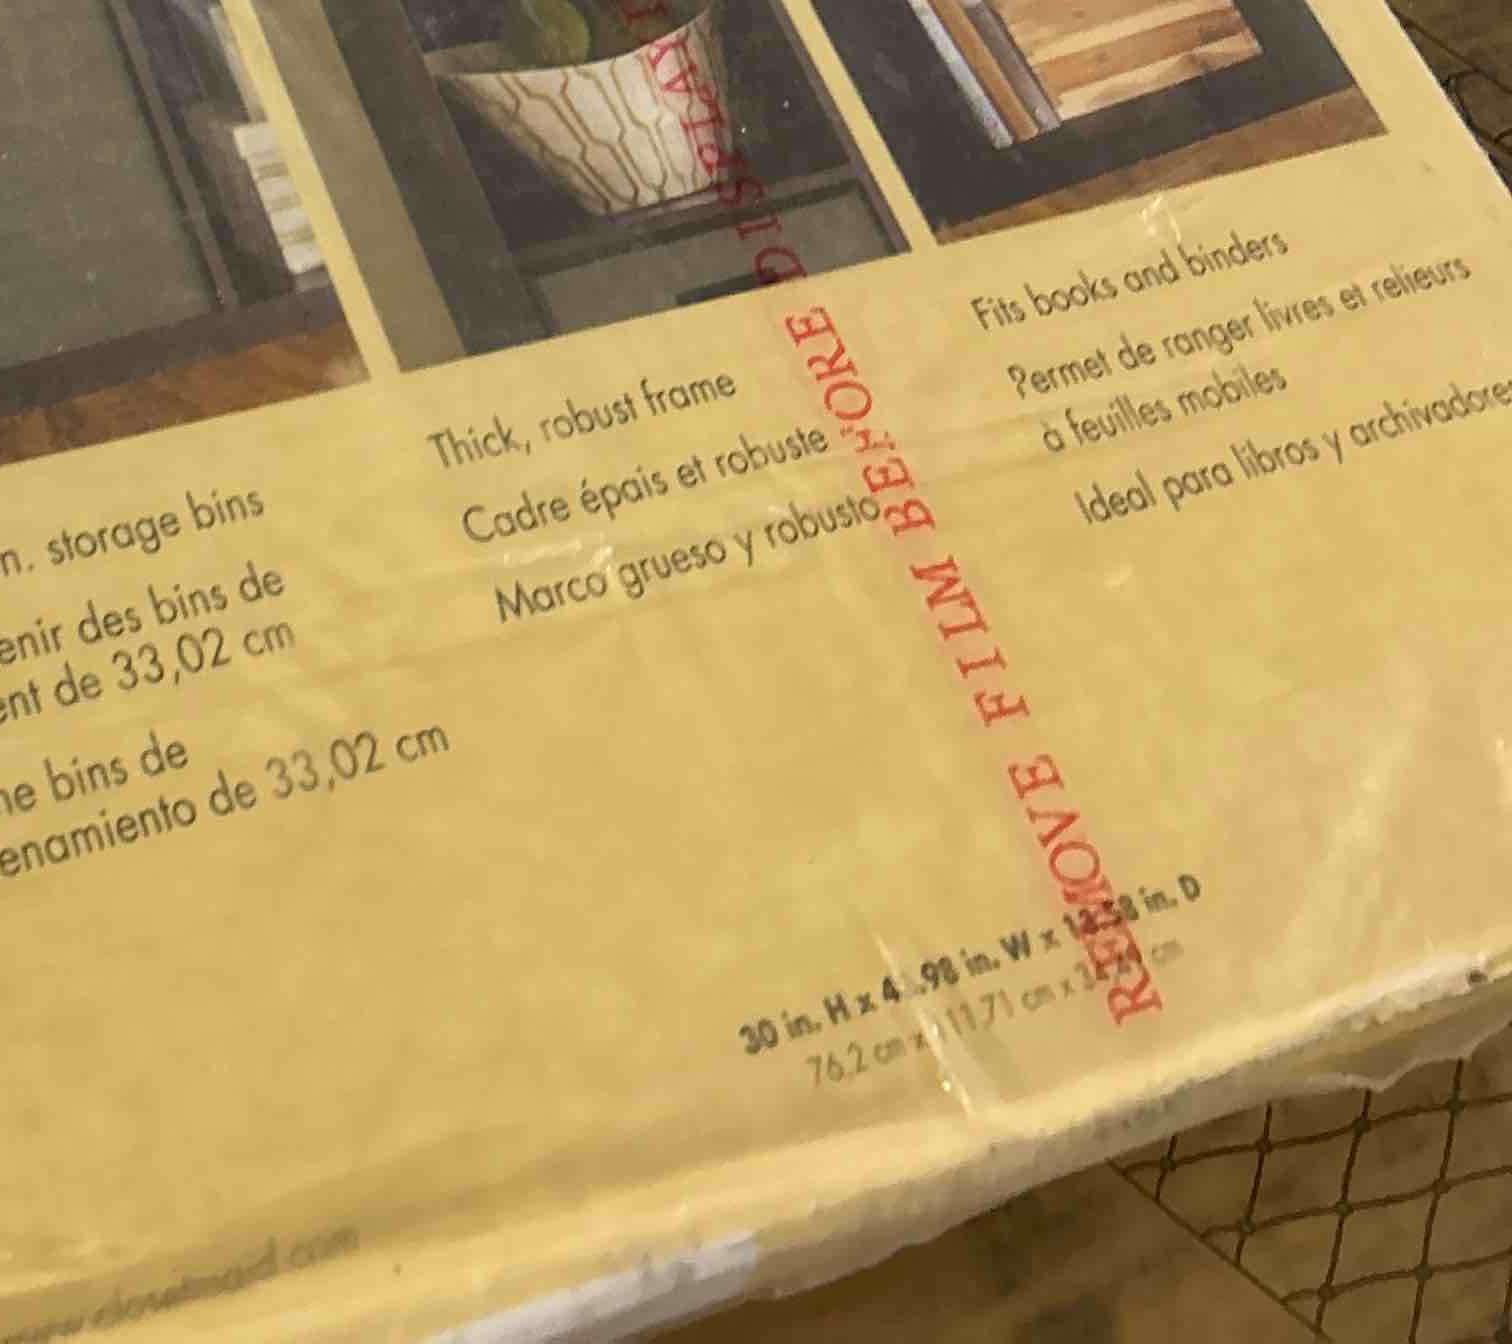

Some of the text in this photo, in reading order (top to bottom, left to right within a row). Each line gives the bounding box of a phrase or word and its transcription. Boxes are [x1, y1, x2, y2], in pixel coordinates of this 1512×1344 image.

[970, 229, 1288, 332] Fits books and binders
[1008, 254, 1471, 400] Permet de ranger livres et relieurs
[428, 372, 737, 470] Thick, robust frame
[784, 305, 935, 537] BEFORE
[1066, 391, 1172, 446] feuilles
[1177, 364, 1287, 414] mobiles
[47, 513, 182, 566] storage
[186, 490, 265, 532] bins
[461, 425, 828, 543] Cadre épais et robuste
[1073, 471, 1157, 526] Ideal
[1162, 462, 1234, 512] para
[1230, 437, 1320, 480] libros
[1326, 427, 1345, 464] y
[78, 601, 142, 643] des
[148, 582, 228, 627] bins
[239, 561, 285, 604] de
[494, 492, 881, 623] Marco grueso y robusto
[54, 665, 103, 708] de
[113, 626, 232, 692] 33,02
[244, 618, 295, 658] cm
[909, 555, 1032, 728] FILM
[44, 759, 128, 802] bins
[140, 732, 188, 776] de
[209, 771, 258, 817] de
[266, 731, 385, 799] 33,02
[396, 722, 450, 763] cm
[1007, 753, 1163, 1026] REMOVE
[738, 1021, 779, 1056] 30
[785, 1007, 823, 1040] in.
[823, 992, 854, 1028] H
[855, 991, 876, 1015] x
[881, 955, 962, 1005] 4.98
[960, 948, 1001, 979] in.
[999, 929, 1034, 962] W
[1039, 927, 1061, 952] x
[1141, 885, 1179, 914] in.
[1178, 873, 1202, 902] D
[873, 1028, 909, 1064] cm
[1021, 976, 1056, 1012] cm
[1151, 936, 1186, 968] cm
